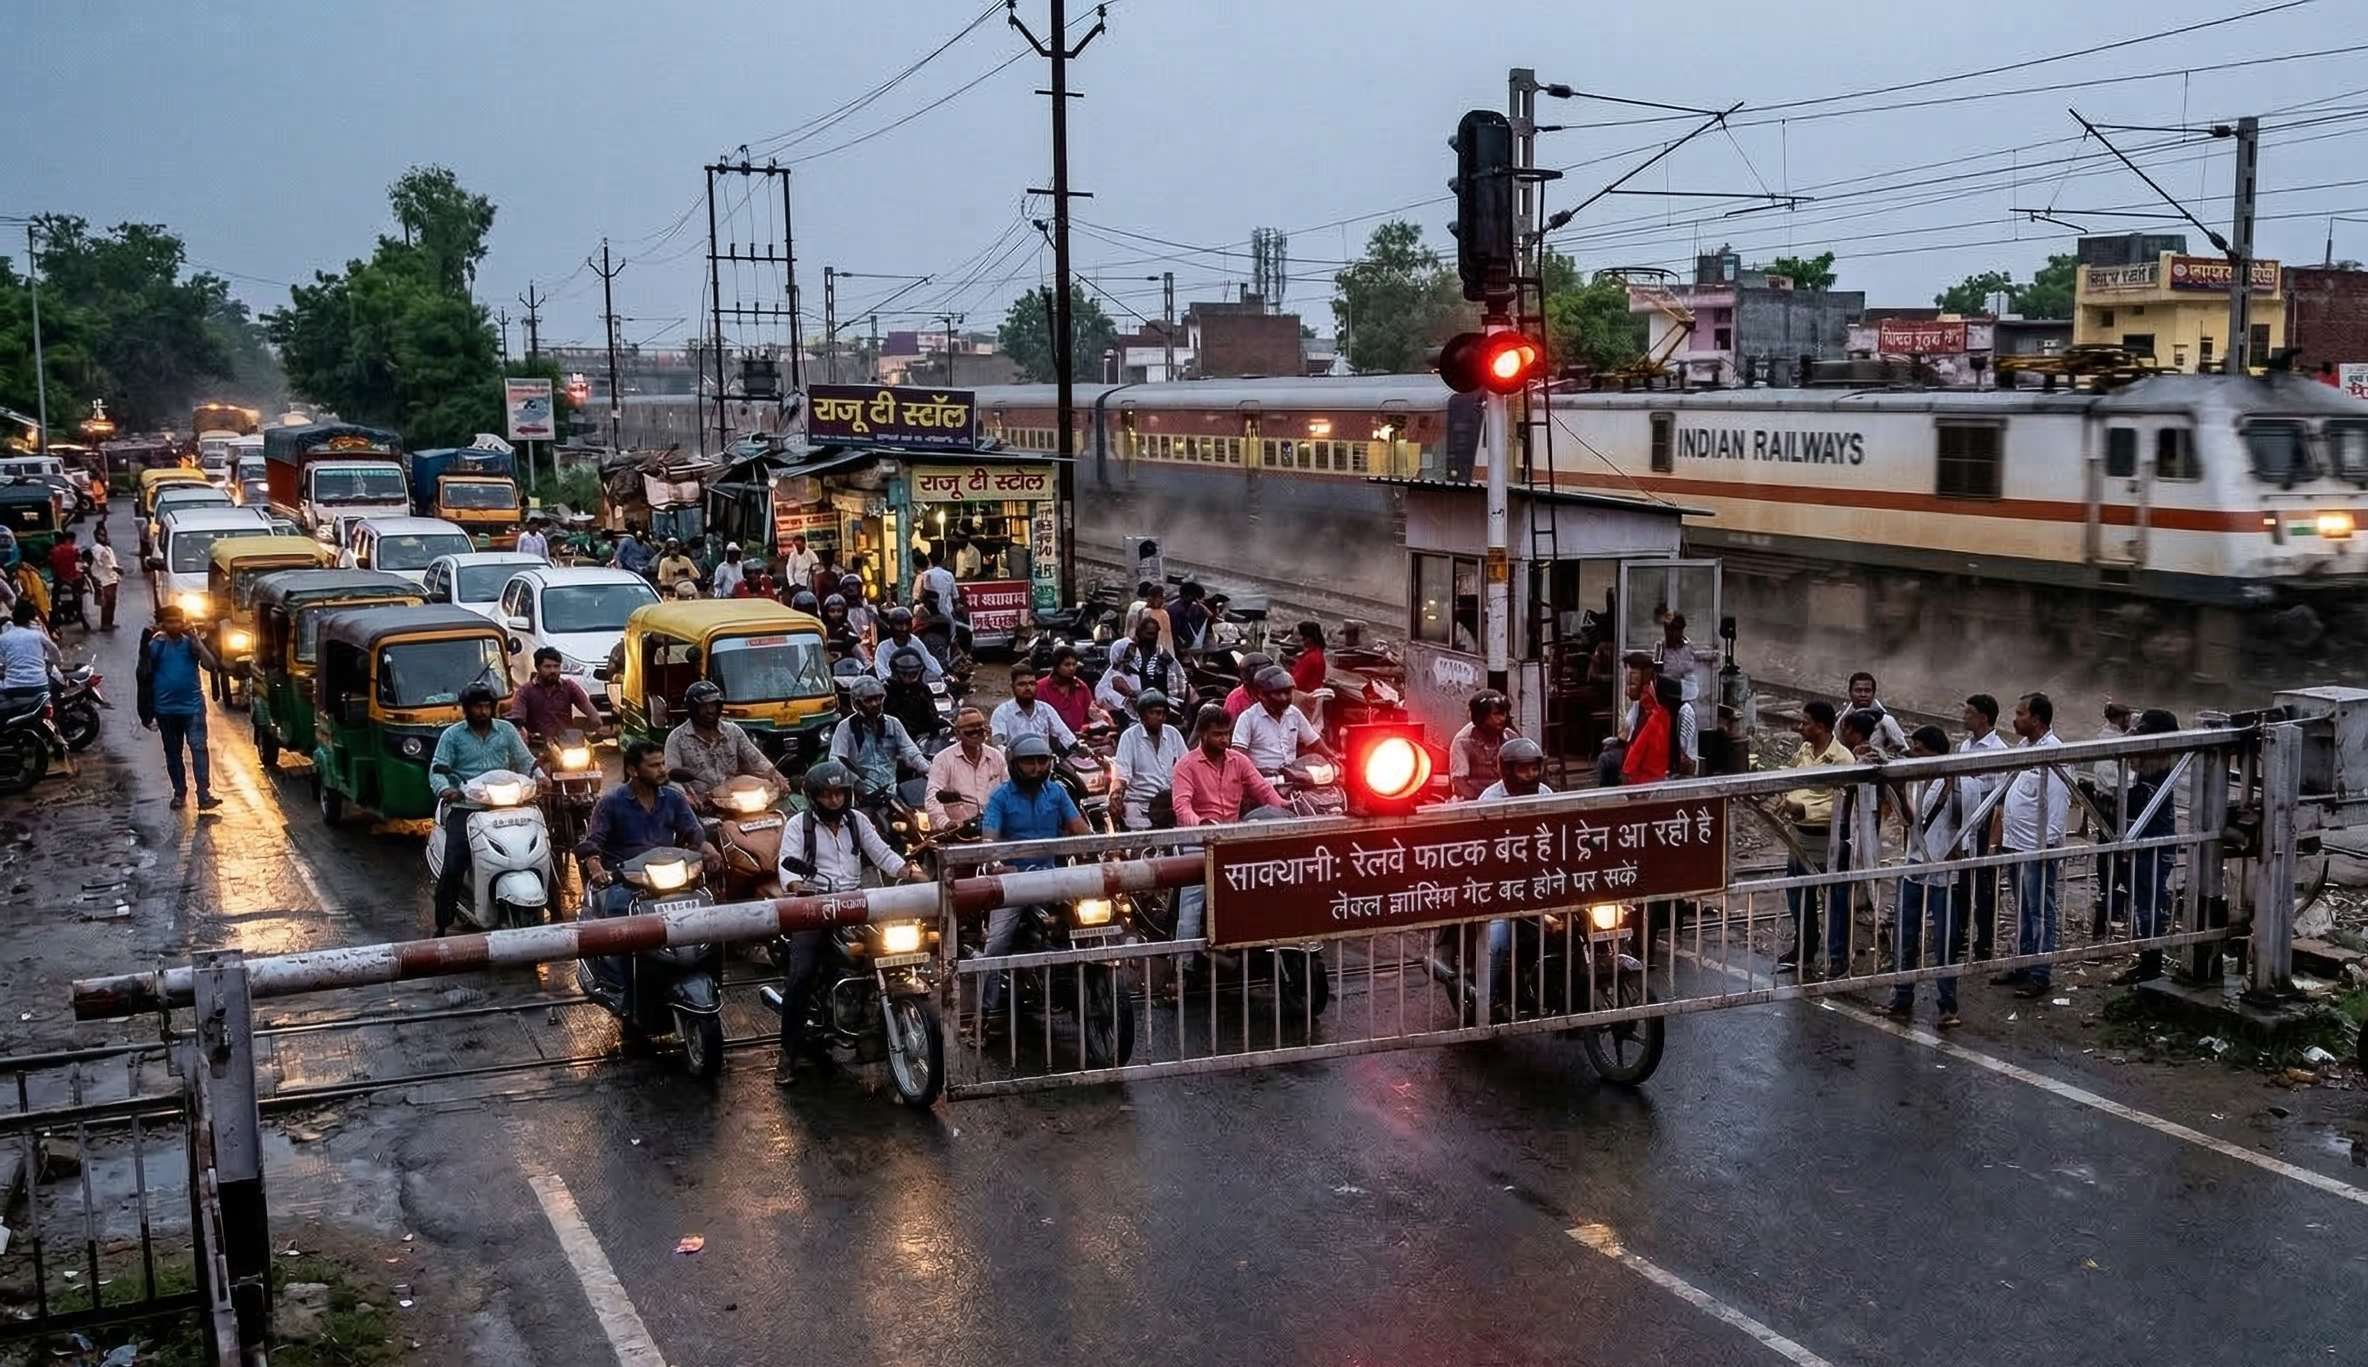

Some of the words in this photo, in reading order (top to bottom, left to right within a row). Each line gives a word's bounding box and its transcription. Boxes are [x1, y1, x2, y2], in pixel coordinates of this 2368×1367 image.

[813, 397, 869, 433] राजू
[869, 390, 896, 424] टी
[901, 394, 969, 428] स्टॉल
[1677, 428, 1745, 460] INDIAN
[1753, 430, 1864, 466] RAILWAYS
[918, 475, 964, 499] राजू
[968, 467, 989, 490] टी
[1349, 837, 1406, 877] रेलवे
[1413, 840, 1488, 870] फाटक
[1494, 829, 1530, 863] बंद
[1618, 823, 1648, 848] आ
[1652, 808, 1691, 847] रही
[1696, 806, 1714, 844] है
[1532, 867, 1567, 899] होने
[1572, 870, 1598, 892] पर
[1603, 859, 1638, 888] सकें
